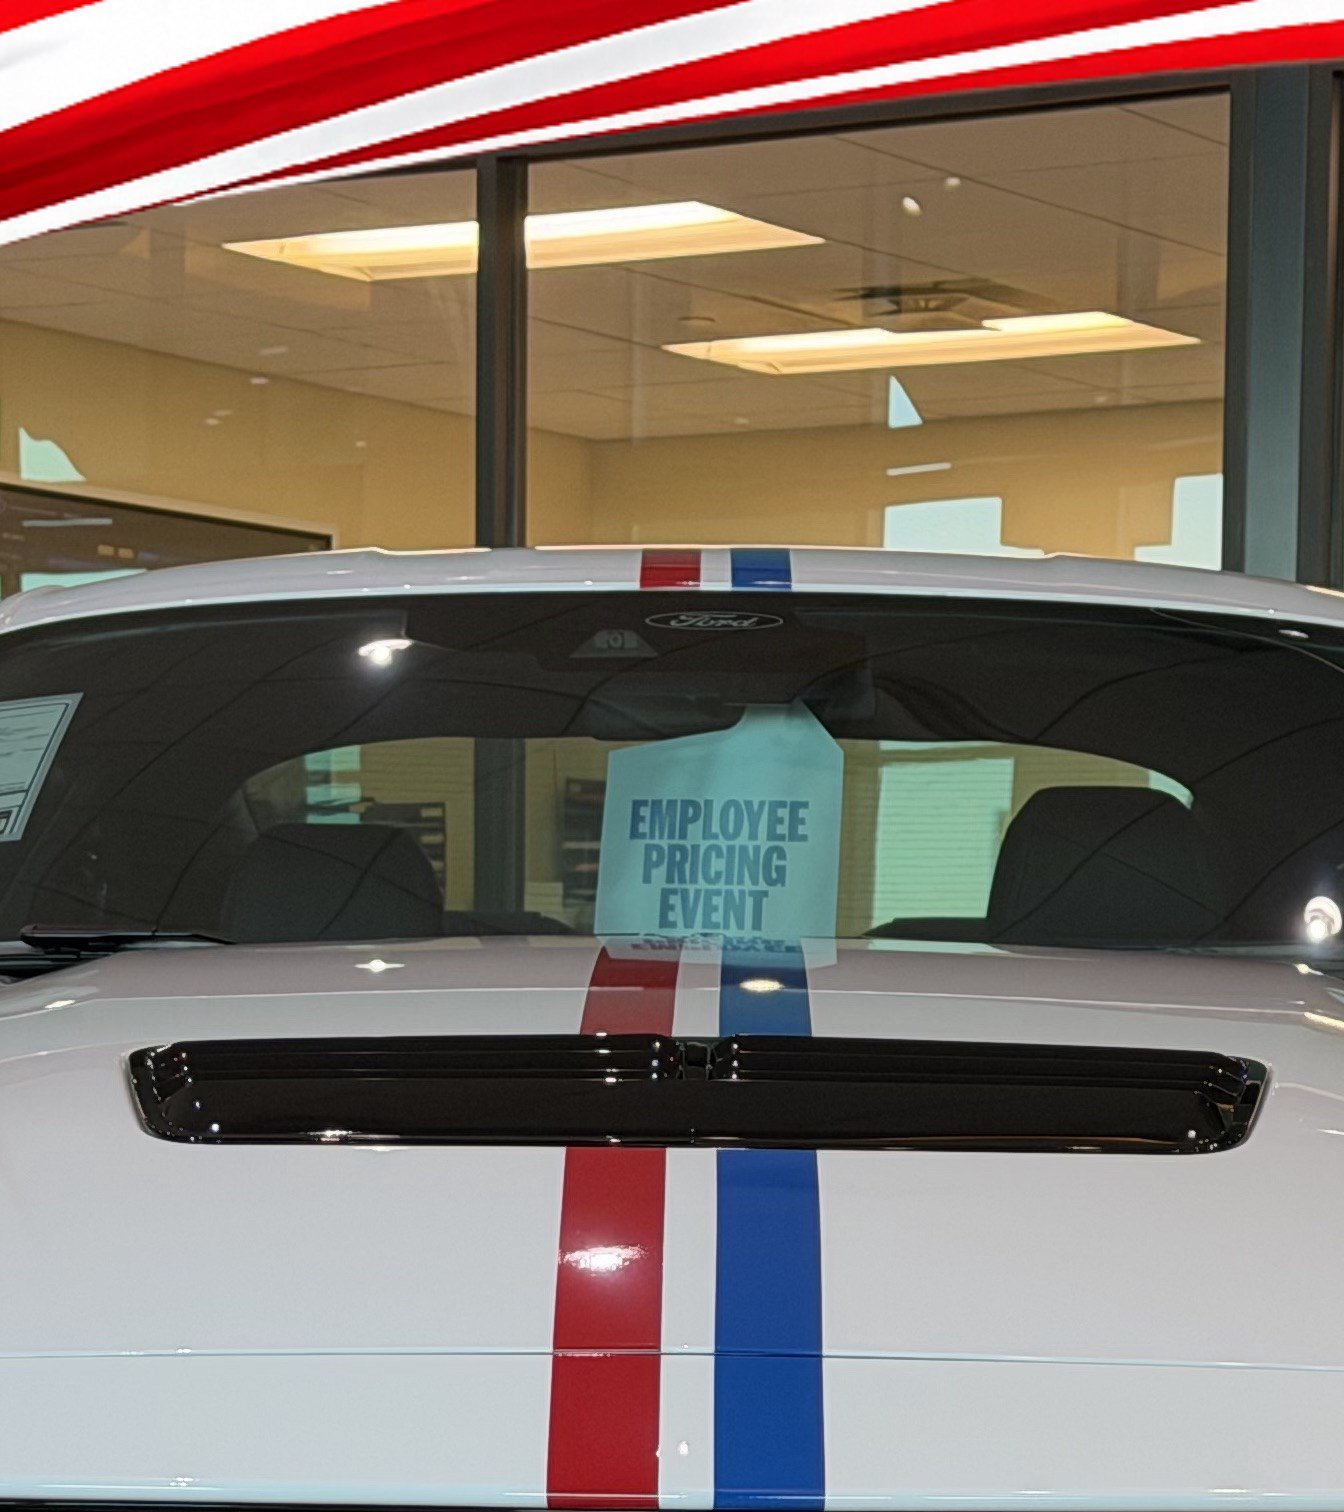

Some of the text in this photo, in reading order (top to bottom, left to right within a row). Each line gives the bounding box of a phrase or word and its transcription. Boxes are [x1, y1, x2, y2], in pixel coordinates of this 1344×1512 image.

[629, 799, 810, 842] EMPLOYEE
[641, 843, 788, 887] PRICING
[658, 887, 769, 932] EVENT
